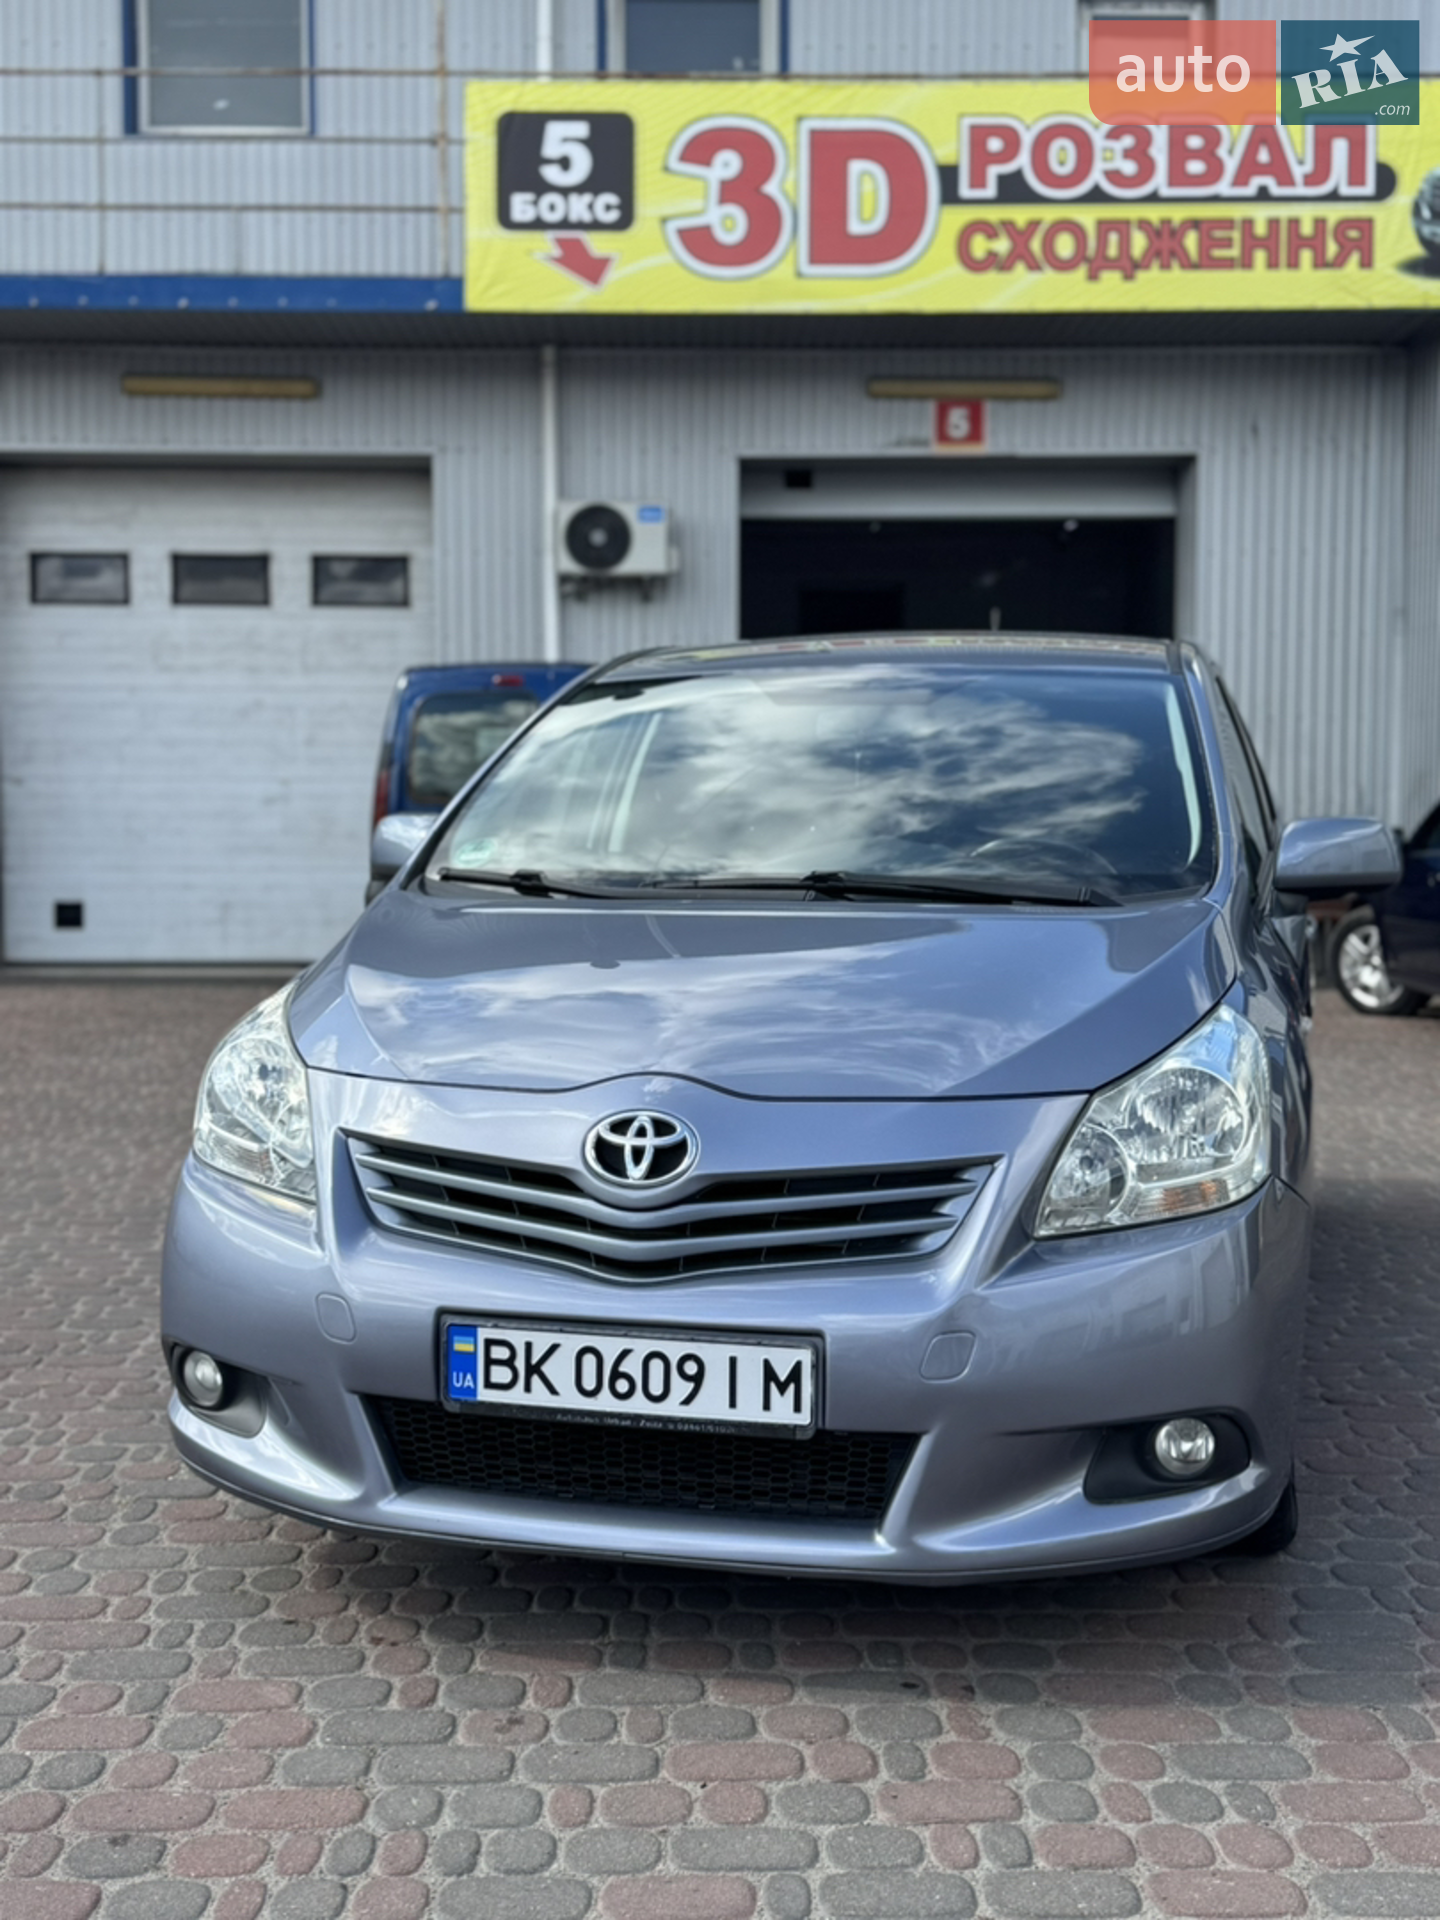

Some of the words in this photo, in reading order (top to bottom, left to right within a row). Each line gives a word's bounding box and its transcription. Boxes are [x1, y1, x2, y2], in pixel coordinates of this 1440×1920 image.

[538, 119, 593, 187] 5
[961, 115, 1376, 198] РОЗВАЛ
[509, 191, 622, 223] БОКС
[664, 116, 939, 278] 3D
[956, 217, 1376, 281] СХОДЖЕННЯ
[946, 406, 971, 439] 5
[452, 1371, 475, 1389] UA
[483, 1337, 562, 1397] BK
[573, 1345, 706, 1407] 0609
